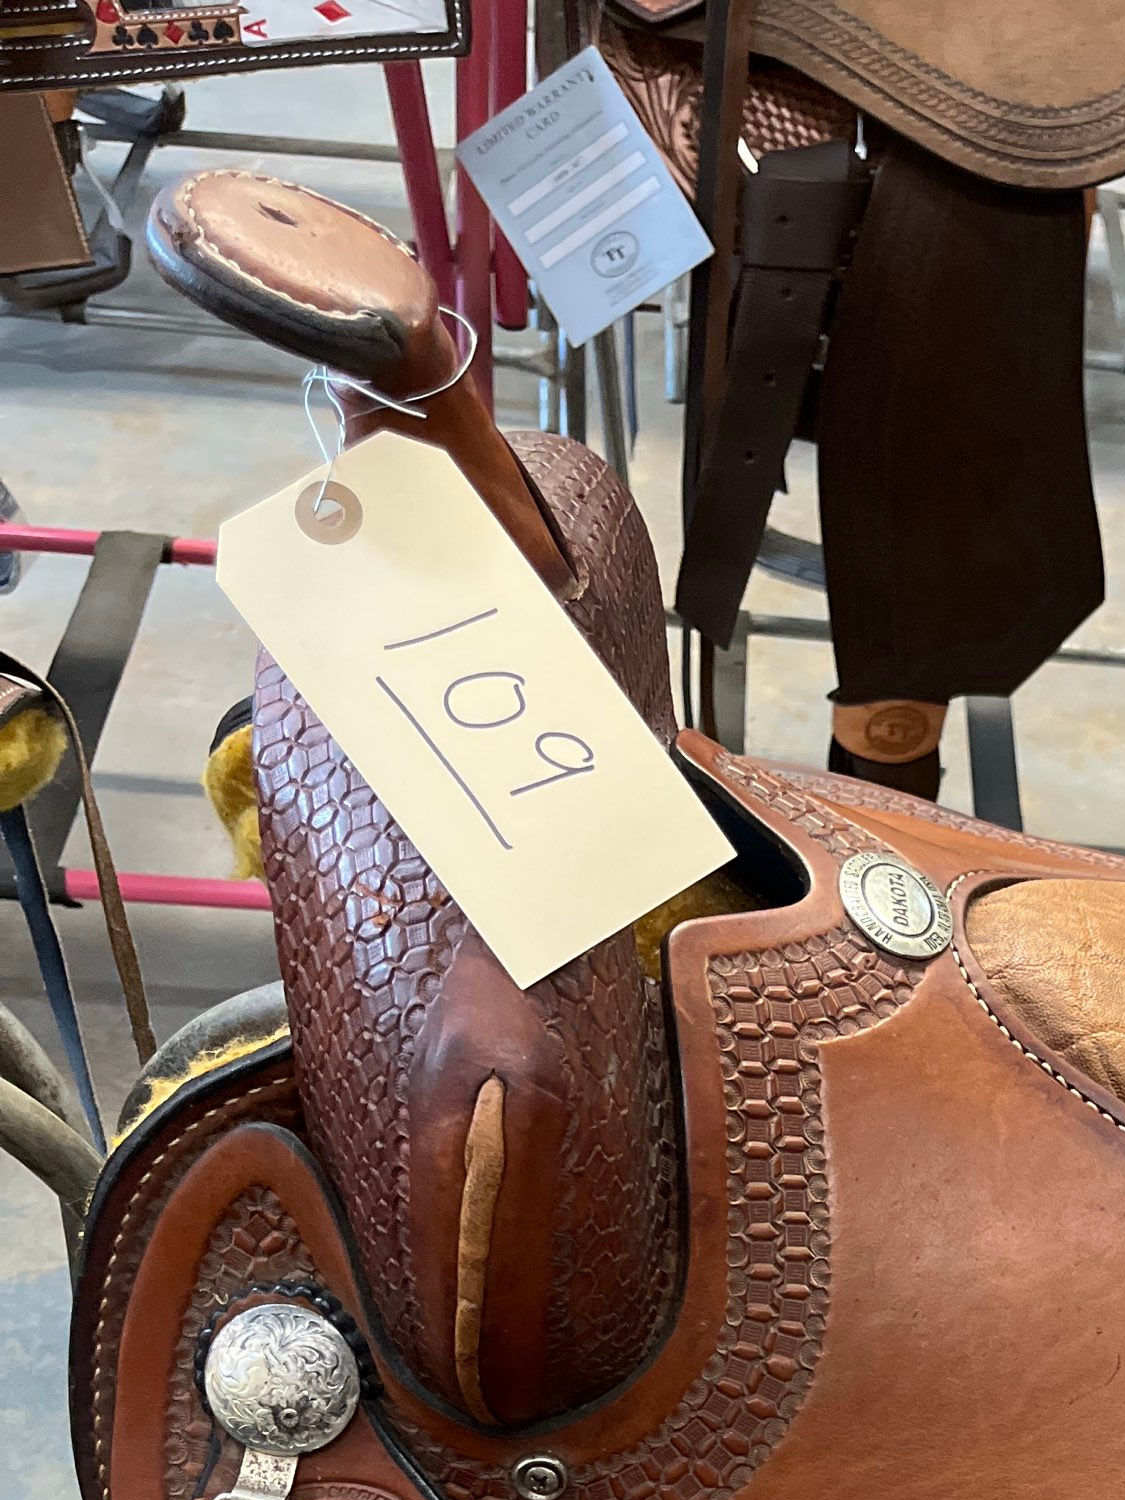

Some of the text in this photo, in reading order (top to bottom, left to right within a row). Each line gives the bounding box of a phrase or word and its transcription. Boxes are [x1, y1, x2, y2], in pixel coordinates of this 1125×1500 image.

[243, 19, 268, 39] A
[477, 115, 525, 155] LIMITED
[525, 67, 595, 116] WARRANTY
[526, 111, 560, 139] CARD
[383, 607, 595, 796] 109
[888, 872, 910, 927] DAKOTA
